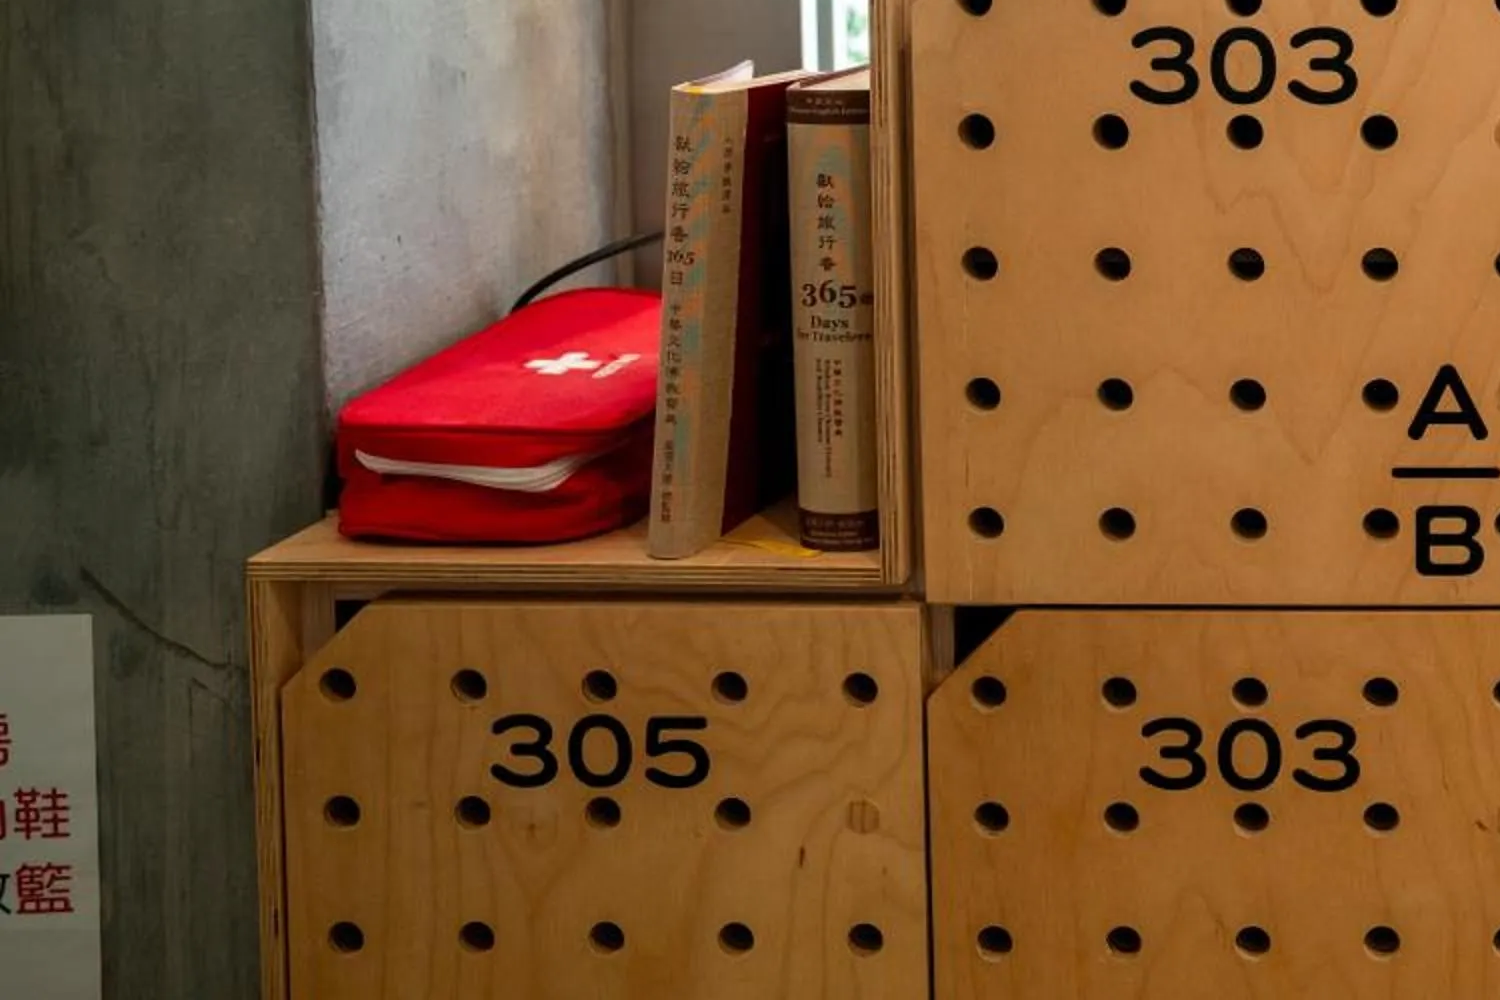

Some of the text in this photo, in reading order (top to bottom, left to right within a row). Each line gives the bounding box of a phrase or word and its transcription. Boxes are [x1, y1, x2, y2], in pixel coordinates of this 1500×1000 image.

[1128, 24, 1360, 107] 303
[801, 279, 857, 309] 365
[810, 315, 849, 331] Days
[1406, 362, 1490, 442] A
[1414, 503, 1486, 578] B
[488, 709, 713, 791] 305
[1137, 715, 1362, 794] 303
[0, 787, 71, 840] 鞋
[0, 862, 74, 916] 籃
